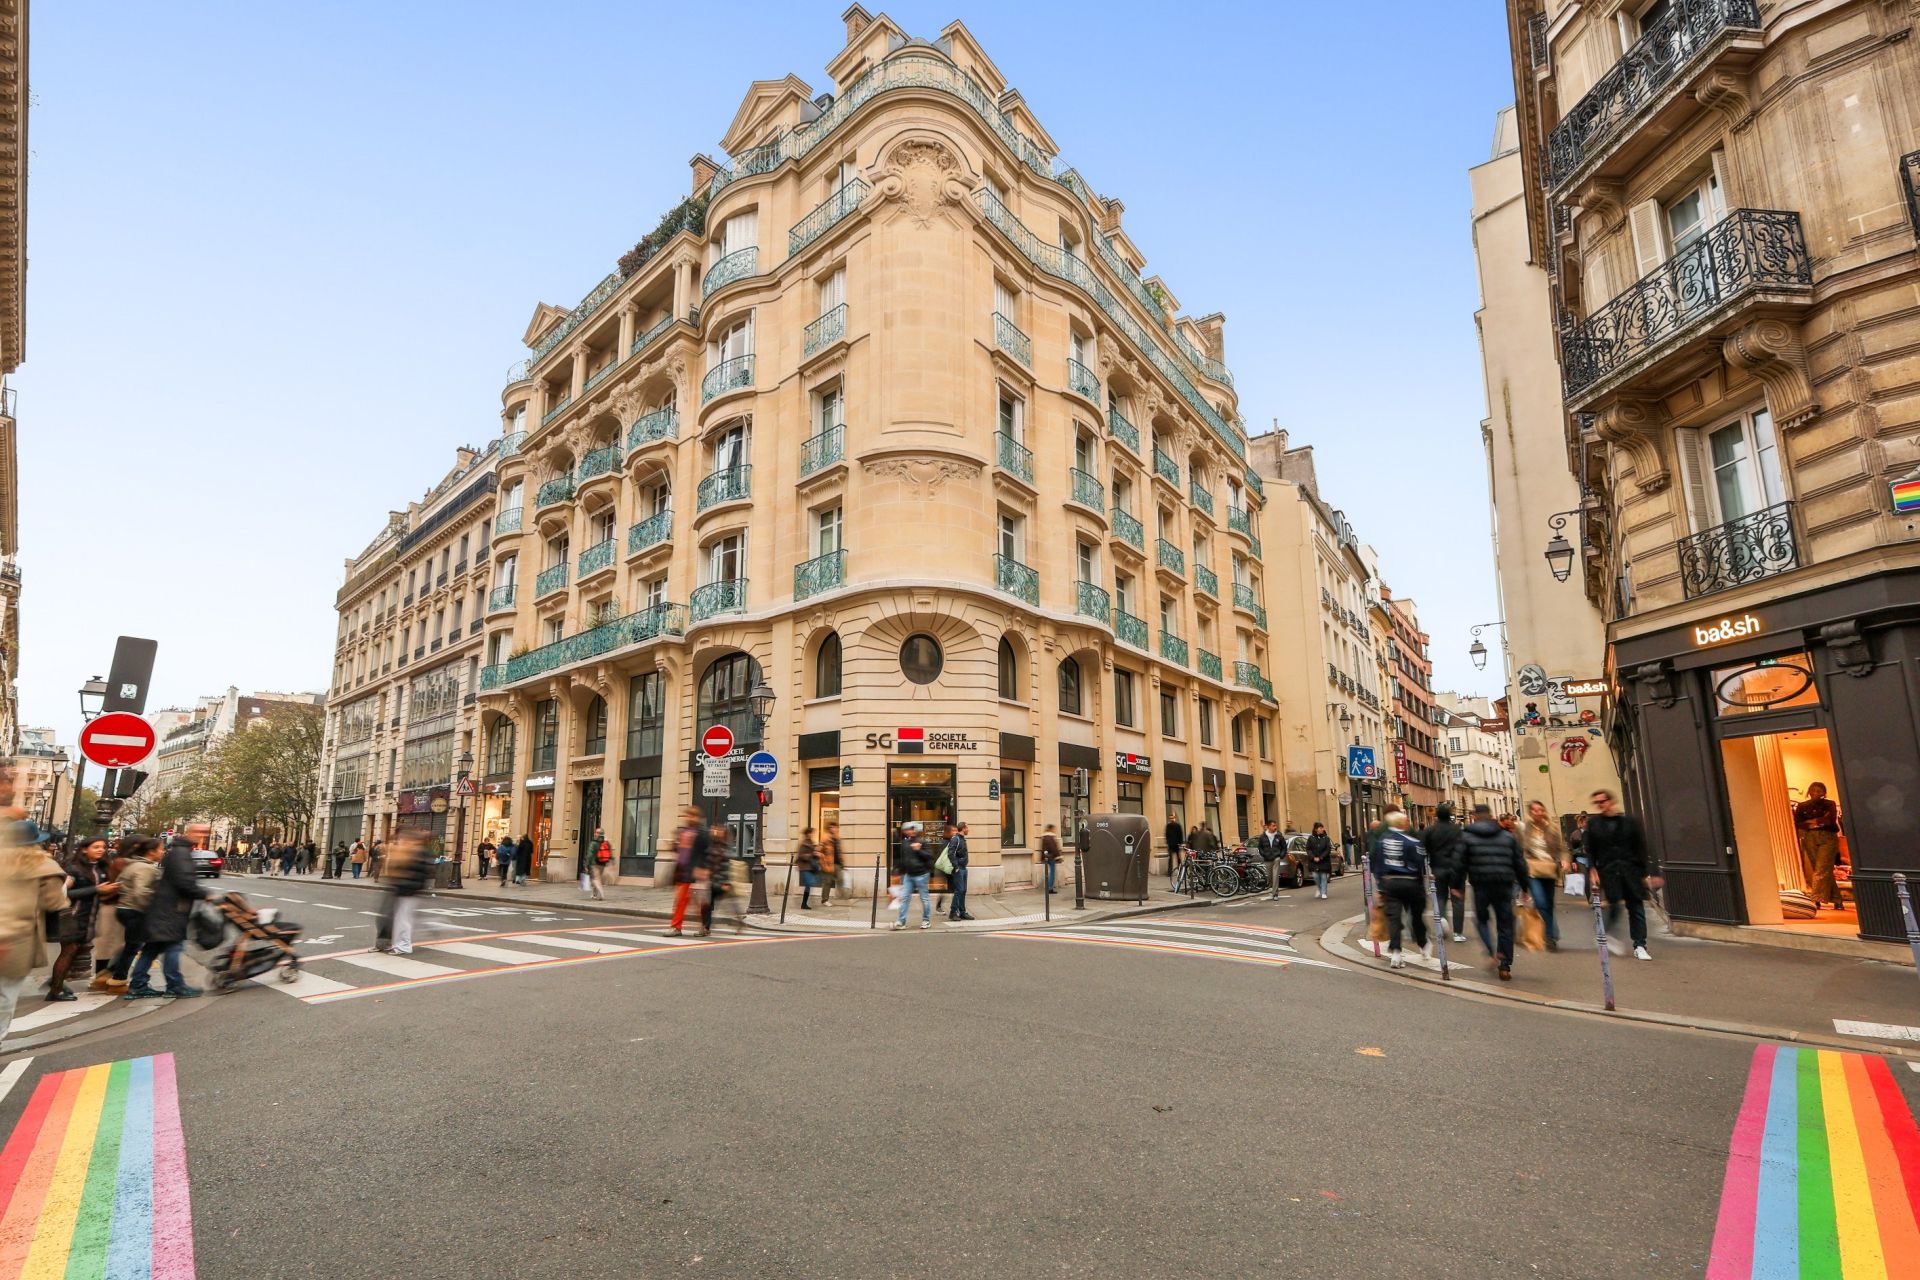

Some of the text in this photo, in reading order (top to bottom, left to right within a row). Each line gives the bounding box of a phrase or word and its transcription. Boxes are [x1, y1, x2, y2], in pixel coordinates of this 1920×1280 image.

[1695, 614, 1760, 645] ba&sh
[1567, 682, 1608, 694] ba&sh
[866, 733, 892, 749] SG
[929, 733, 967, 741] SOCIETE
[929, 742, 977, 750] GENERALE
[1116, 755, 1127, 768] SG
